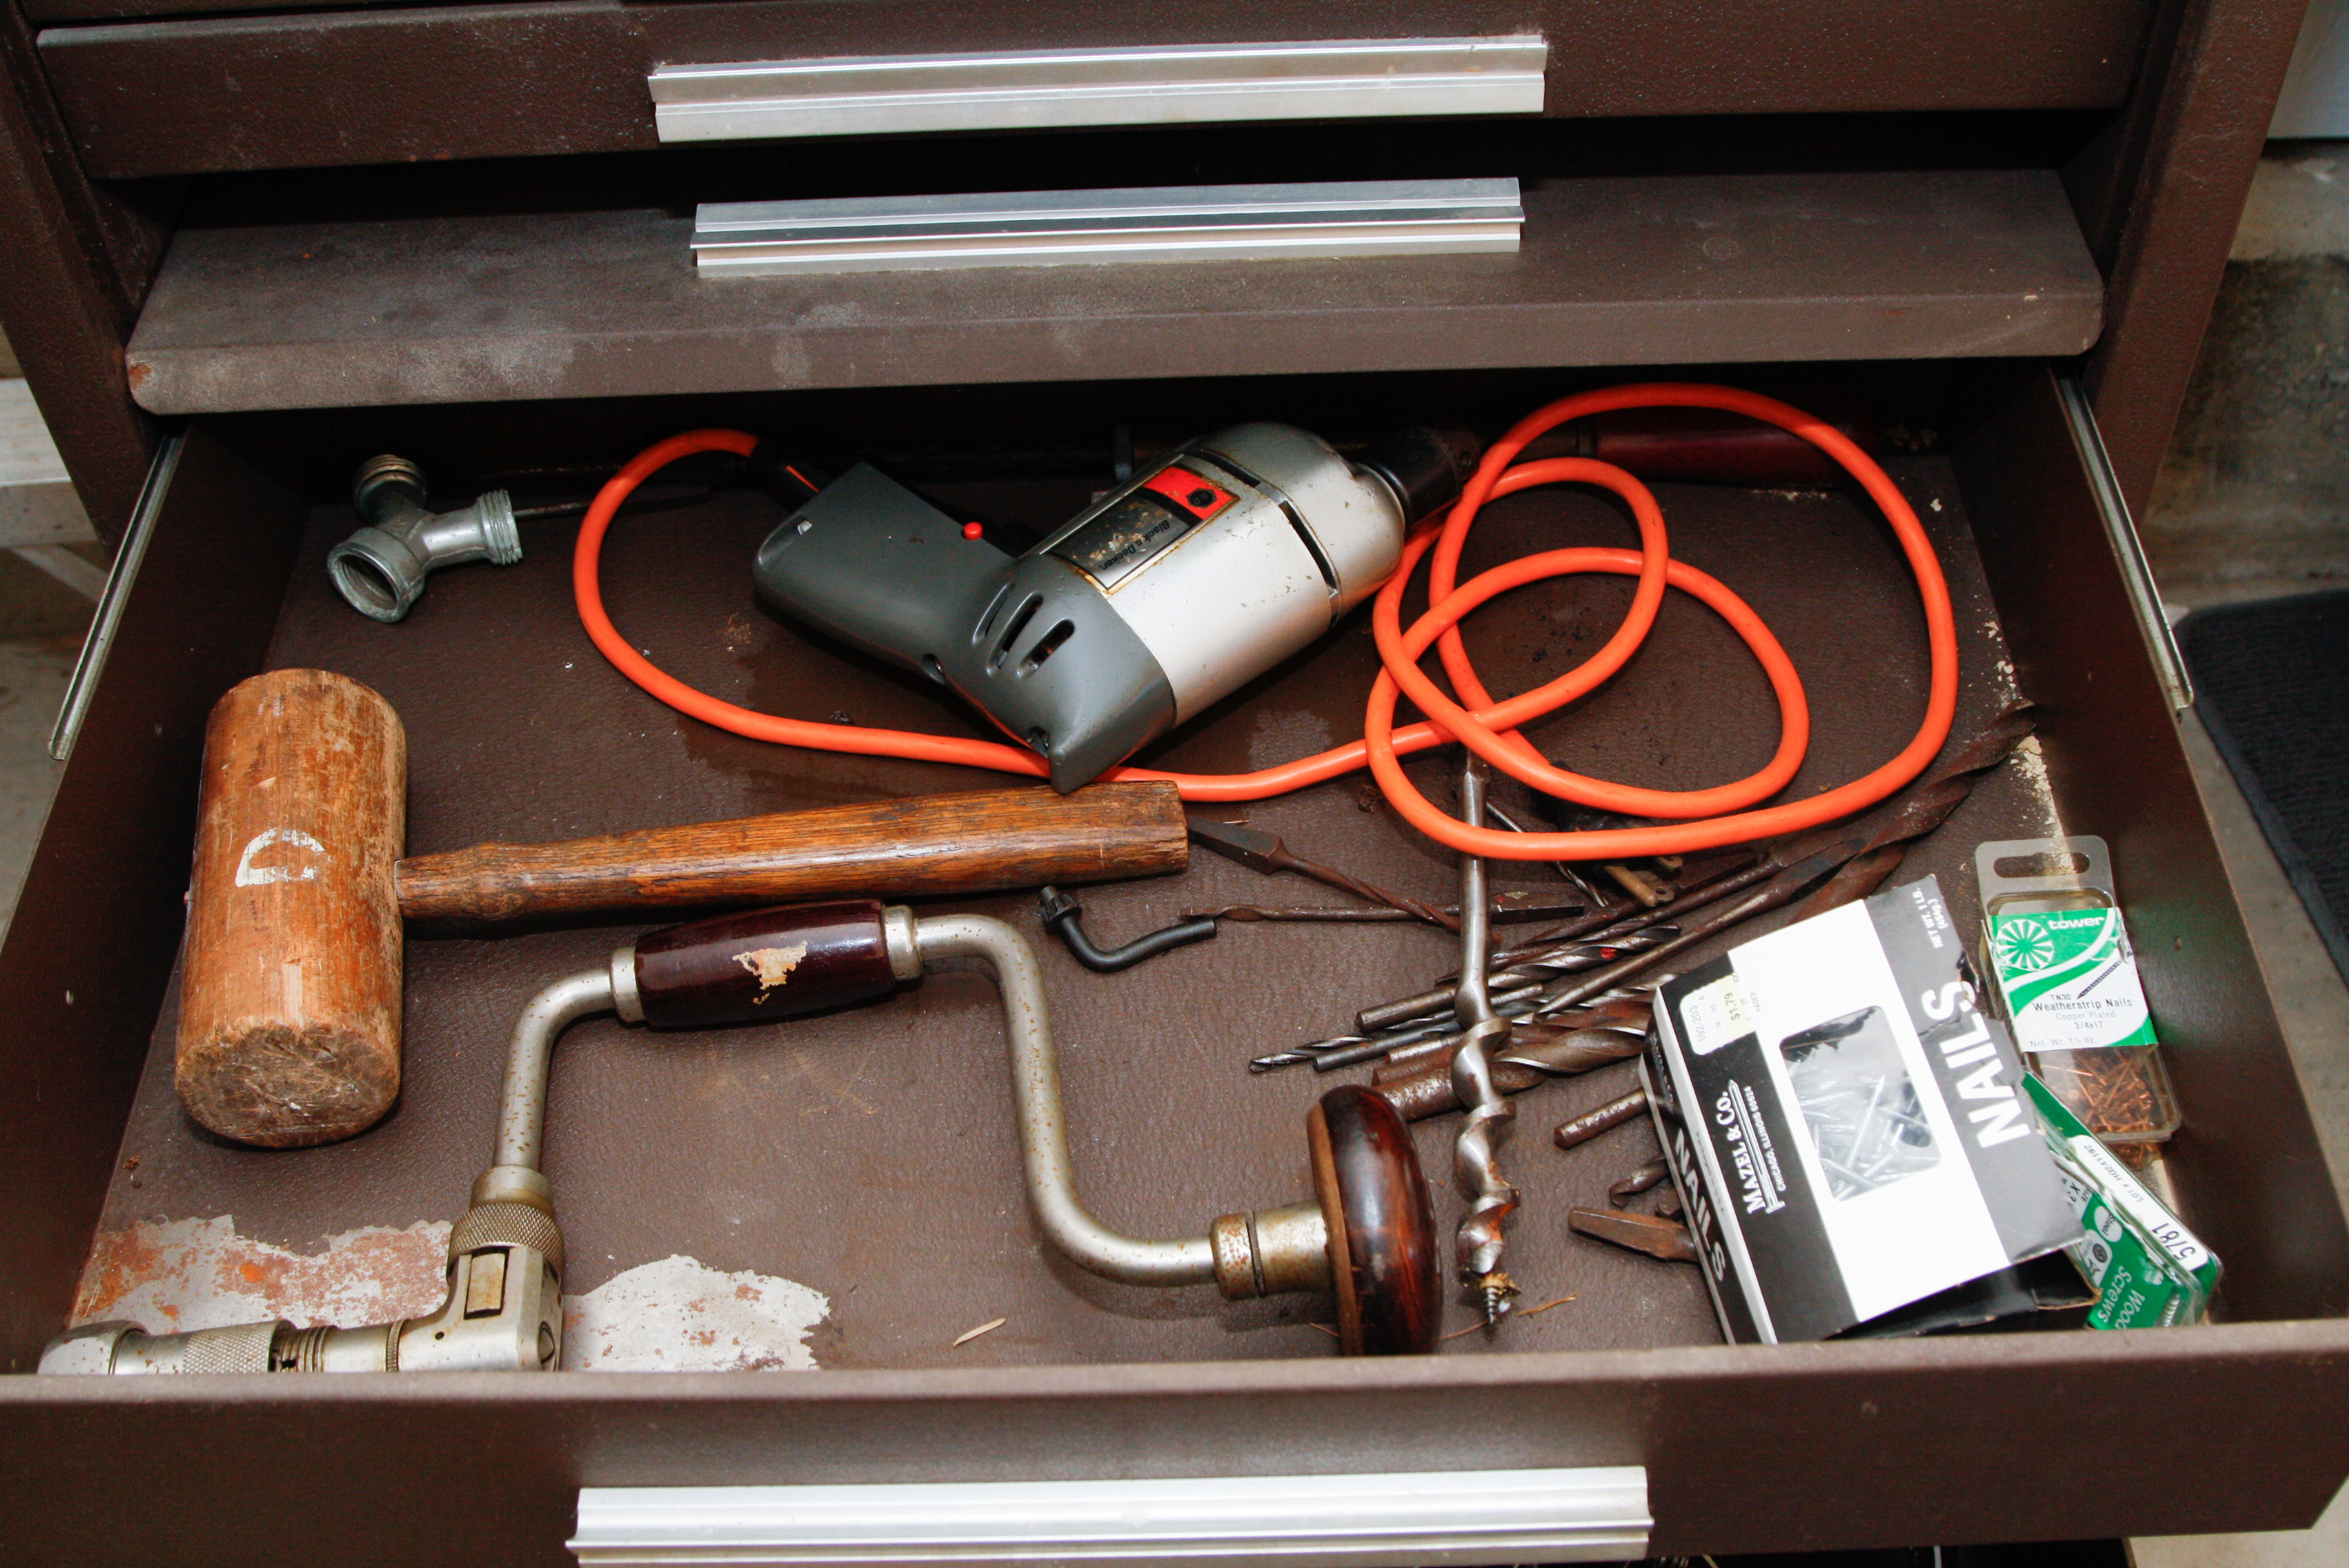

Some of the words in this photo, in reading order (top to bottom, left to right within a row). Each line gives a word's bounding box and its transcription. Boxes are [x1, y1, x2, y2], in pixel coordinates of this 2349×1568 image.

[1145, 520, 1170, 543] Black
[1913, 887, 1925, 904] LB.
[1921, 911, 1935, 929] WT.
[2047, 916, 2105, 931] tower
[1928, 930, 1944, 948] NET
[1724, 993, 1741, 1021] $1.79
[2033, 1000, 2101, 1012] Weatherstrip
[2105, 998, 2133, 1008] Nails
[2055, 1012, 2085, 1021] Copper
[2090, 1010, 2116, 1018] Plated
[1689, 1004, 1707, 1043] 192-203
[2074, 1020, 2103, 1030] 3/4x17
[1922, 980, 2031, 1149] NAILS
[1727, 1124, 1742, 1141] &
[1753, 1111, 1772, 1149] ILLINOIS
[1732, 1142, 1766, 1214] MAZEL
[1765, 1148, 1787, 1192] CHICAGO,
[1675, 1128, 1726, 1281] NAILS
[2125, 1188, 2144, 1203] LOT
[2151, 1222, 2197, 1261] 5781
[2096, 1265, 2133, 1324] Screws
